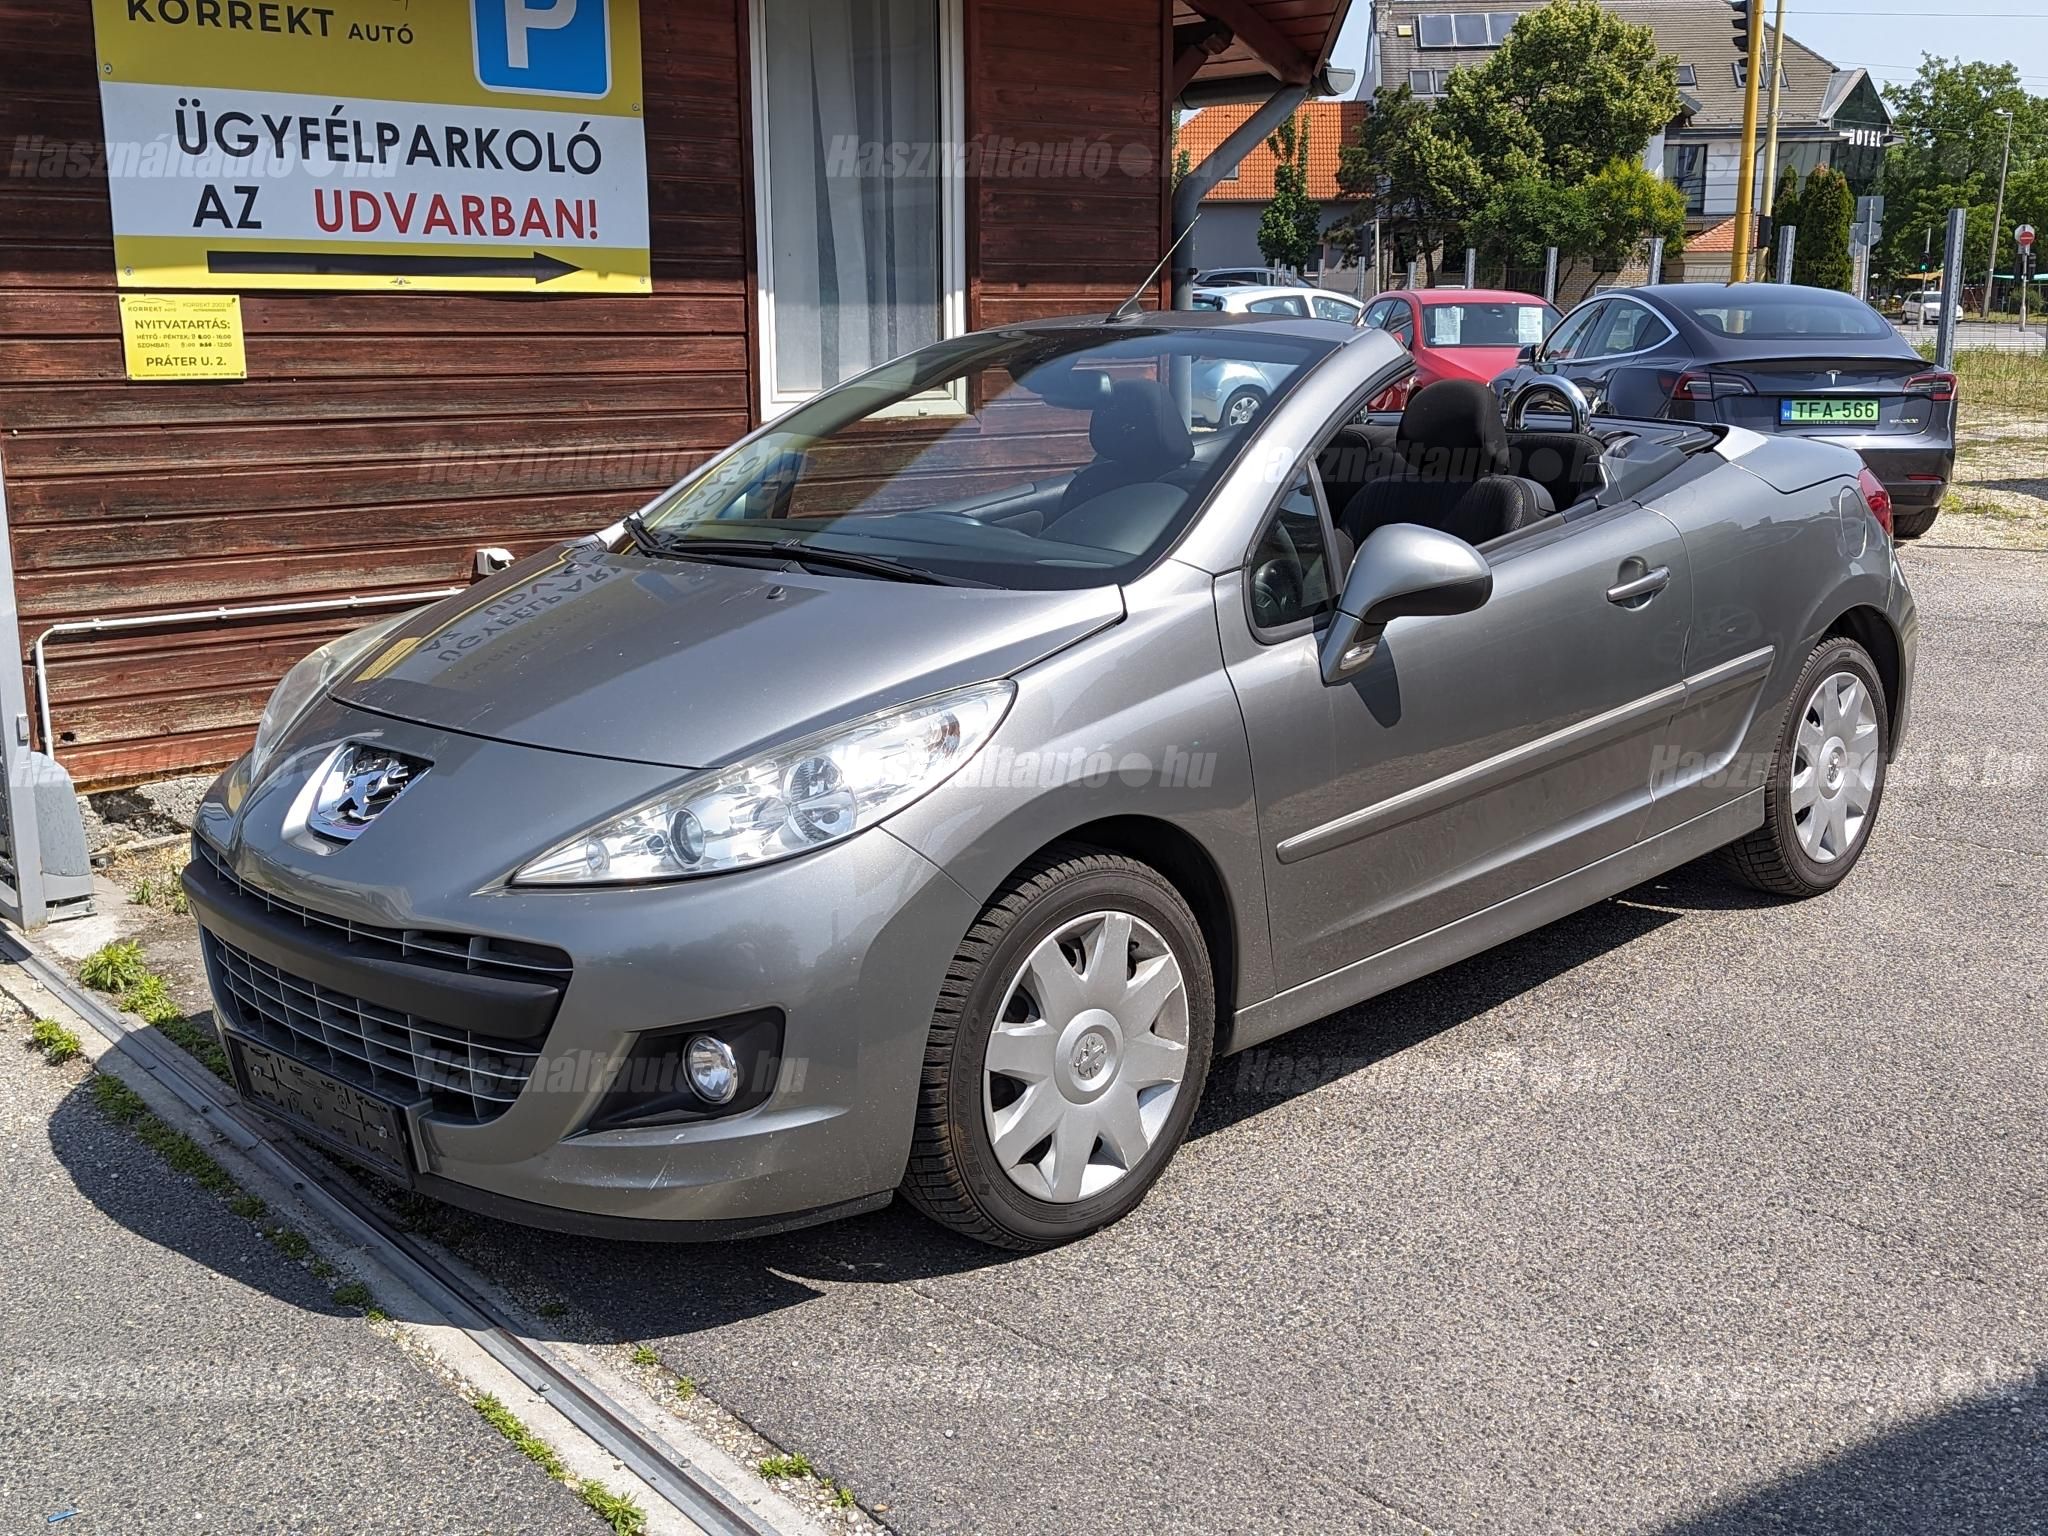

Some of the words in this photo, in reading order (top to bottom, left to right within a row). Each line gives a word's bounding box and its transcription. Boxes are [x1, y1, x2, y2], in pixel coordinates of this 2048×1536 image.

[127, 0, 334, 36] KORREKT
[348, 23, 413, 44] AUTÓ
[175, 98, 602, 175] ÜGYFÉLPARKOLÓ
[1849, 128, 1881, 147] HOTEL
[193, 184, 262, 230] AZ
[313, 188, 599, 240] UDVARBAN!
[135, 318, 231, 329] NYITVATARTÁS:
[146, 354, 197, 367] PRÁTER
[201, 356, 213, 366] U.
[216, 356, 227, 366] 2.
[1796, 402, 1875, 418] TFA-566
